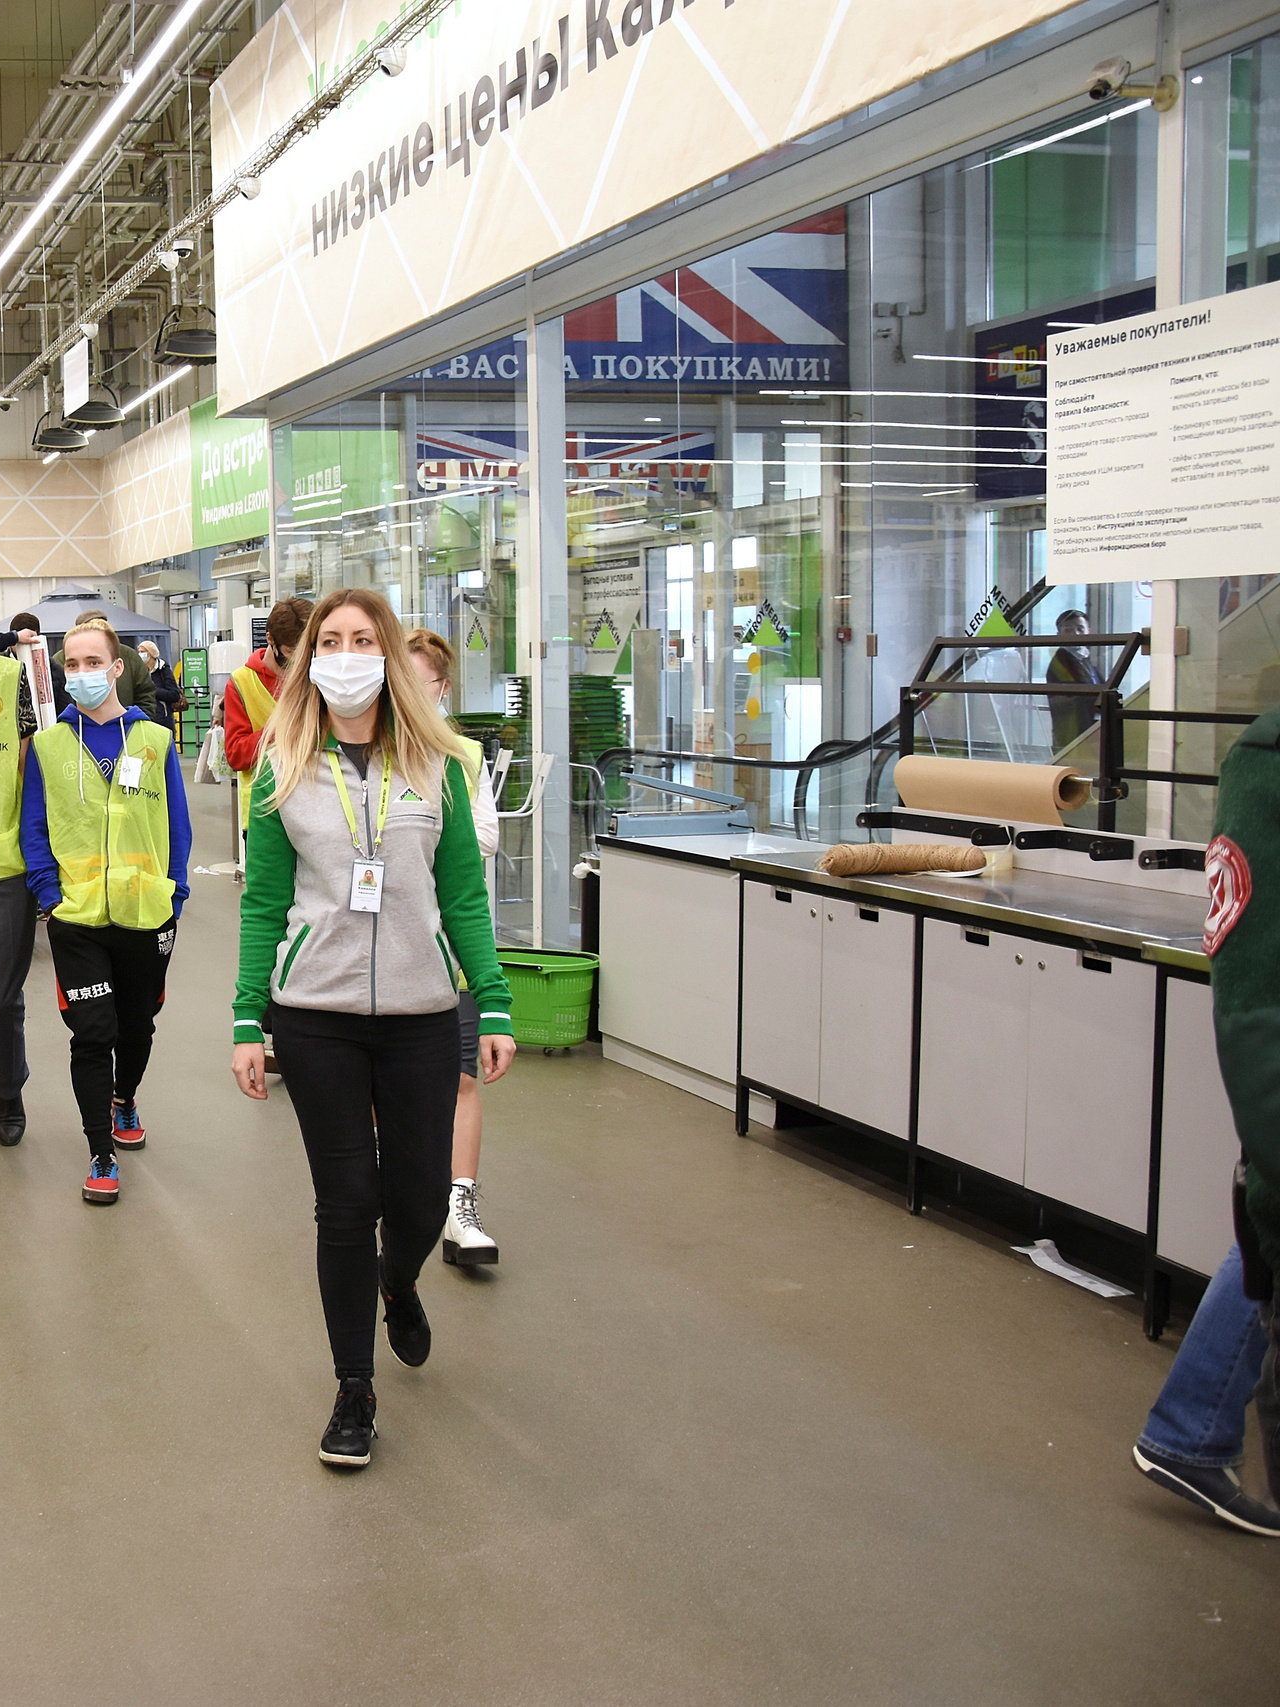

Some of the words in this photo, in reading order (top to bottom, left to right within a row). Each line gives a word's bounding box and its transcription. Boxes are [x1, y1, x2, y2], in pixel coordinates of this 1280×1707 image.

[311, 121, 434, 257] низкие
[446, 16, 571, 176] цены
[1055, 331, 1127, 356] Уважаемые
[1130, 309, 1212, 340] покупатели!
[449, 357, 520, 380] ВАС
[592, 355, 832, 382] ПОКУПКАМИ!
[1055, 380, 1068, 389] При
[1069, 368, 1126, 385] самостоятельной
[1128, 362, 1159, 376] проверке
[1161, 356, 1190, 368] техники
[1197, 344, 1252, 361] комплектации
[1170, 374, 1204, 386] Помните,
[1055, 394, 1095, 406] Соблюдайте
[1055, 407, 1081, 419] правила
[201, 440, 221, 490] До
[201, 505, 234, 526] Увидимся
[235, 500, 244, 517] на
[1096, 519, 1135, 531] Инструкцией
[1099, 541, 1150, 552] Информационное
[1151, 540, 1167, 549] бюро
[965, 595, 993, 637] LEROY
